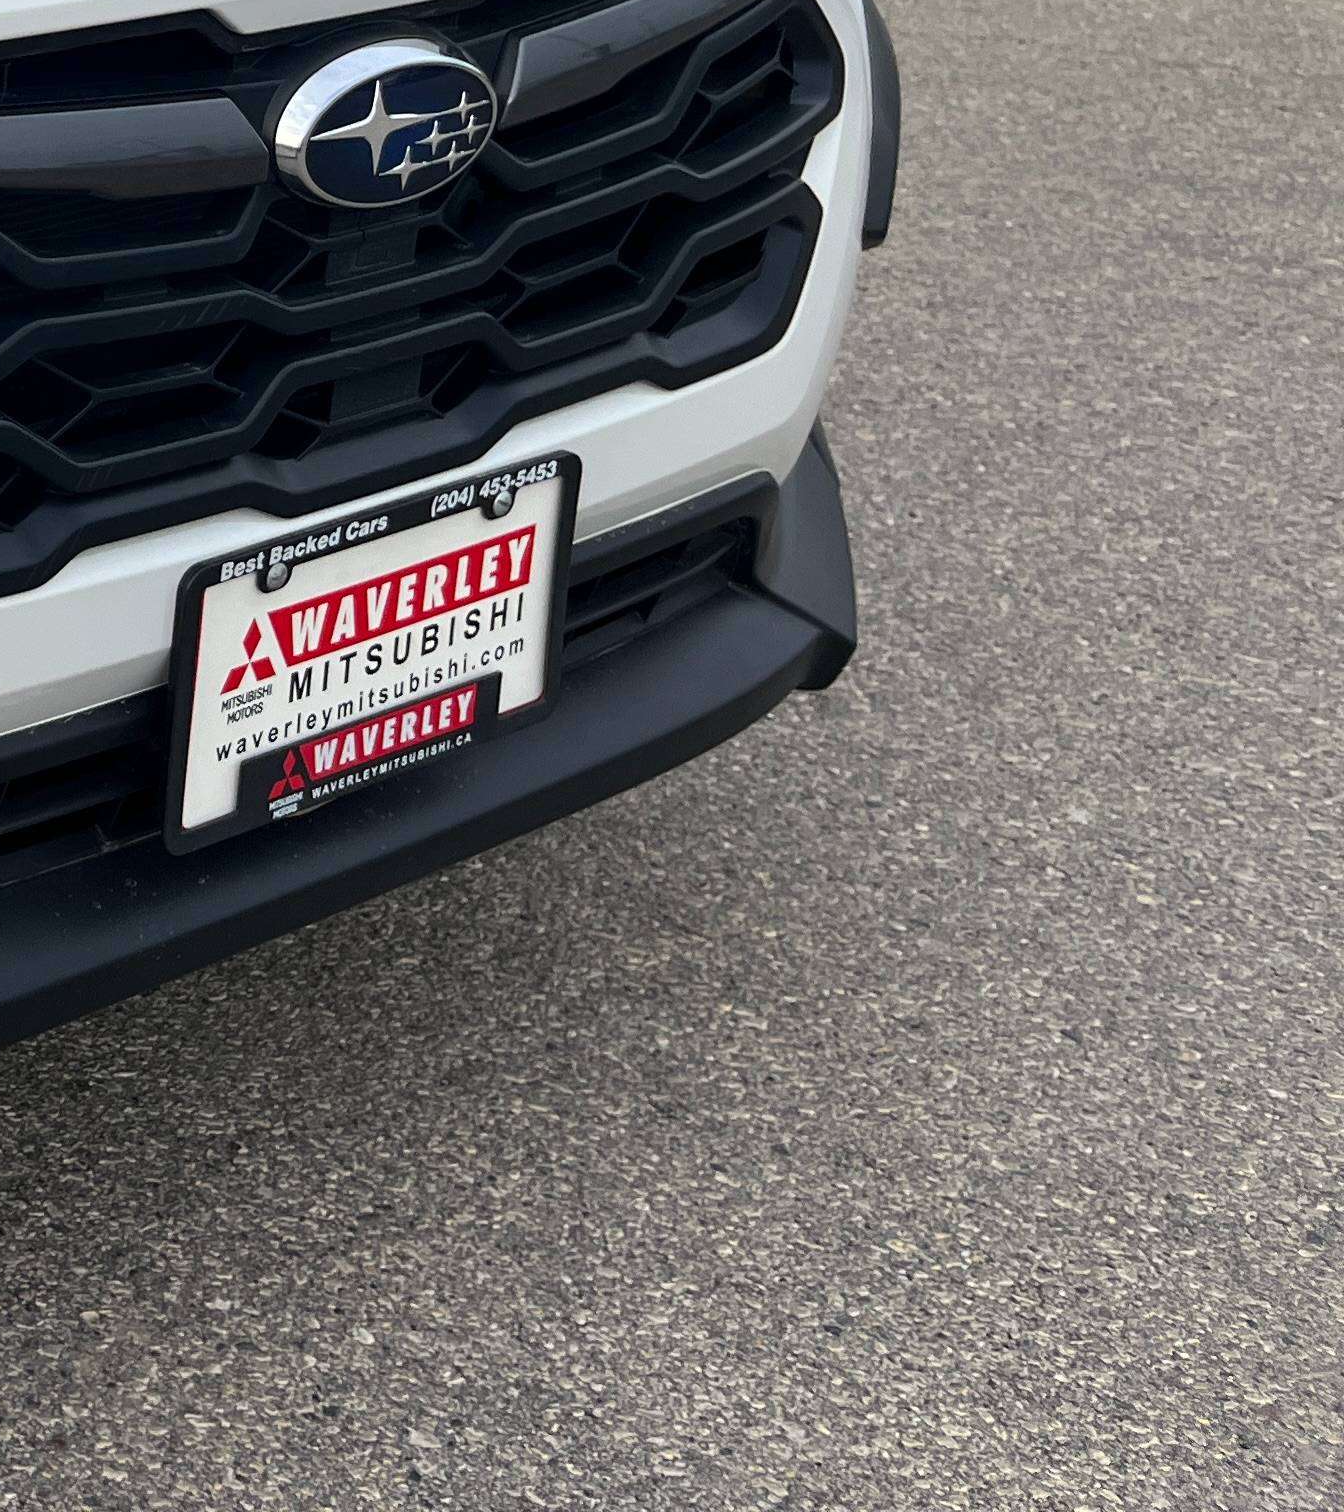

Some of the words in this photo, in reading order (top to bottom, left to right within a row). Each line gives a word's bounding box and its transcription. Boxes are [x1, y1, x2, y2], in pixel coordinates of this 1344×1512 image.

[429, 483, 475, 518] (204)
[478, 459, 559, 500] 453-5453
[220, 551, 265, 582] Best
[268, 526, 341, 567] Backed
[345, 514, 389, 542] Cars
[289, 532, 532, 658] WAVERLEY
[287, 591, 525, 704] MITSUBISHI
[215, 637, 525, 762] waverleymitsubishi.com
[220, 683, 273, 713] MITSUBISHI
[226, 701, 264, 726] MOTORS
[313, 688, 477, 775] WAVERLEY
[311, 732, 473, 800] WAVERLEYMITSUBISHI.CA
